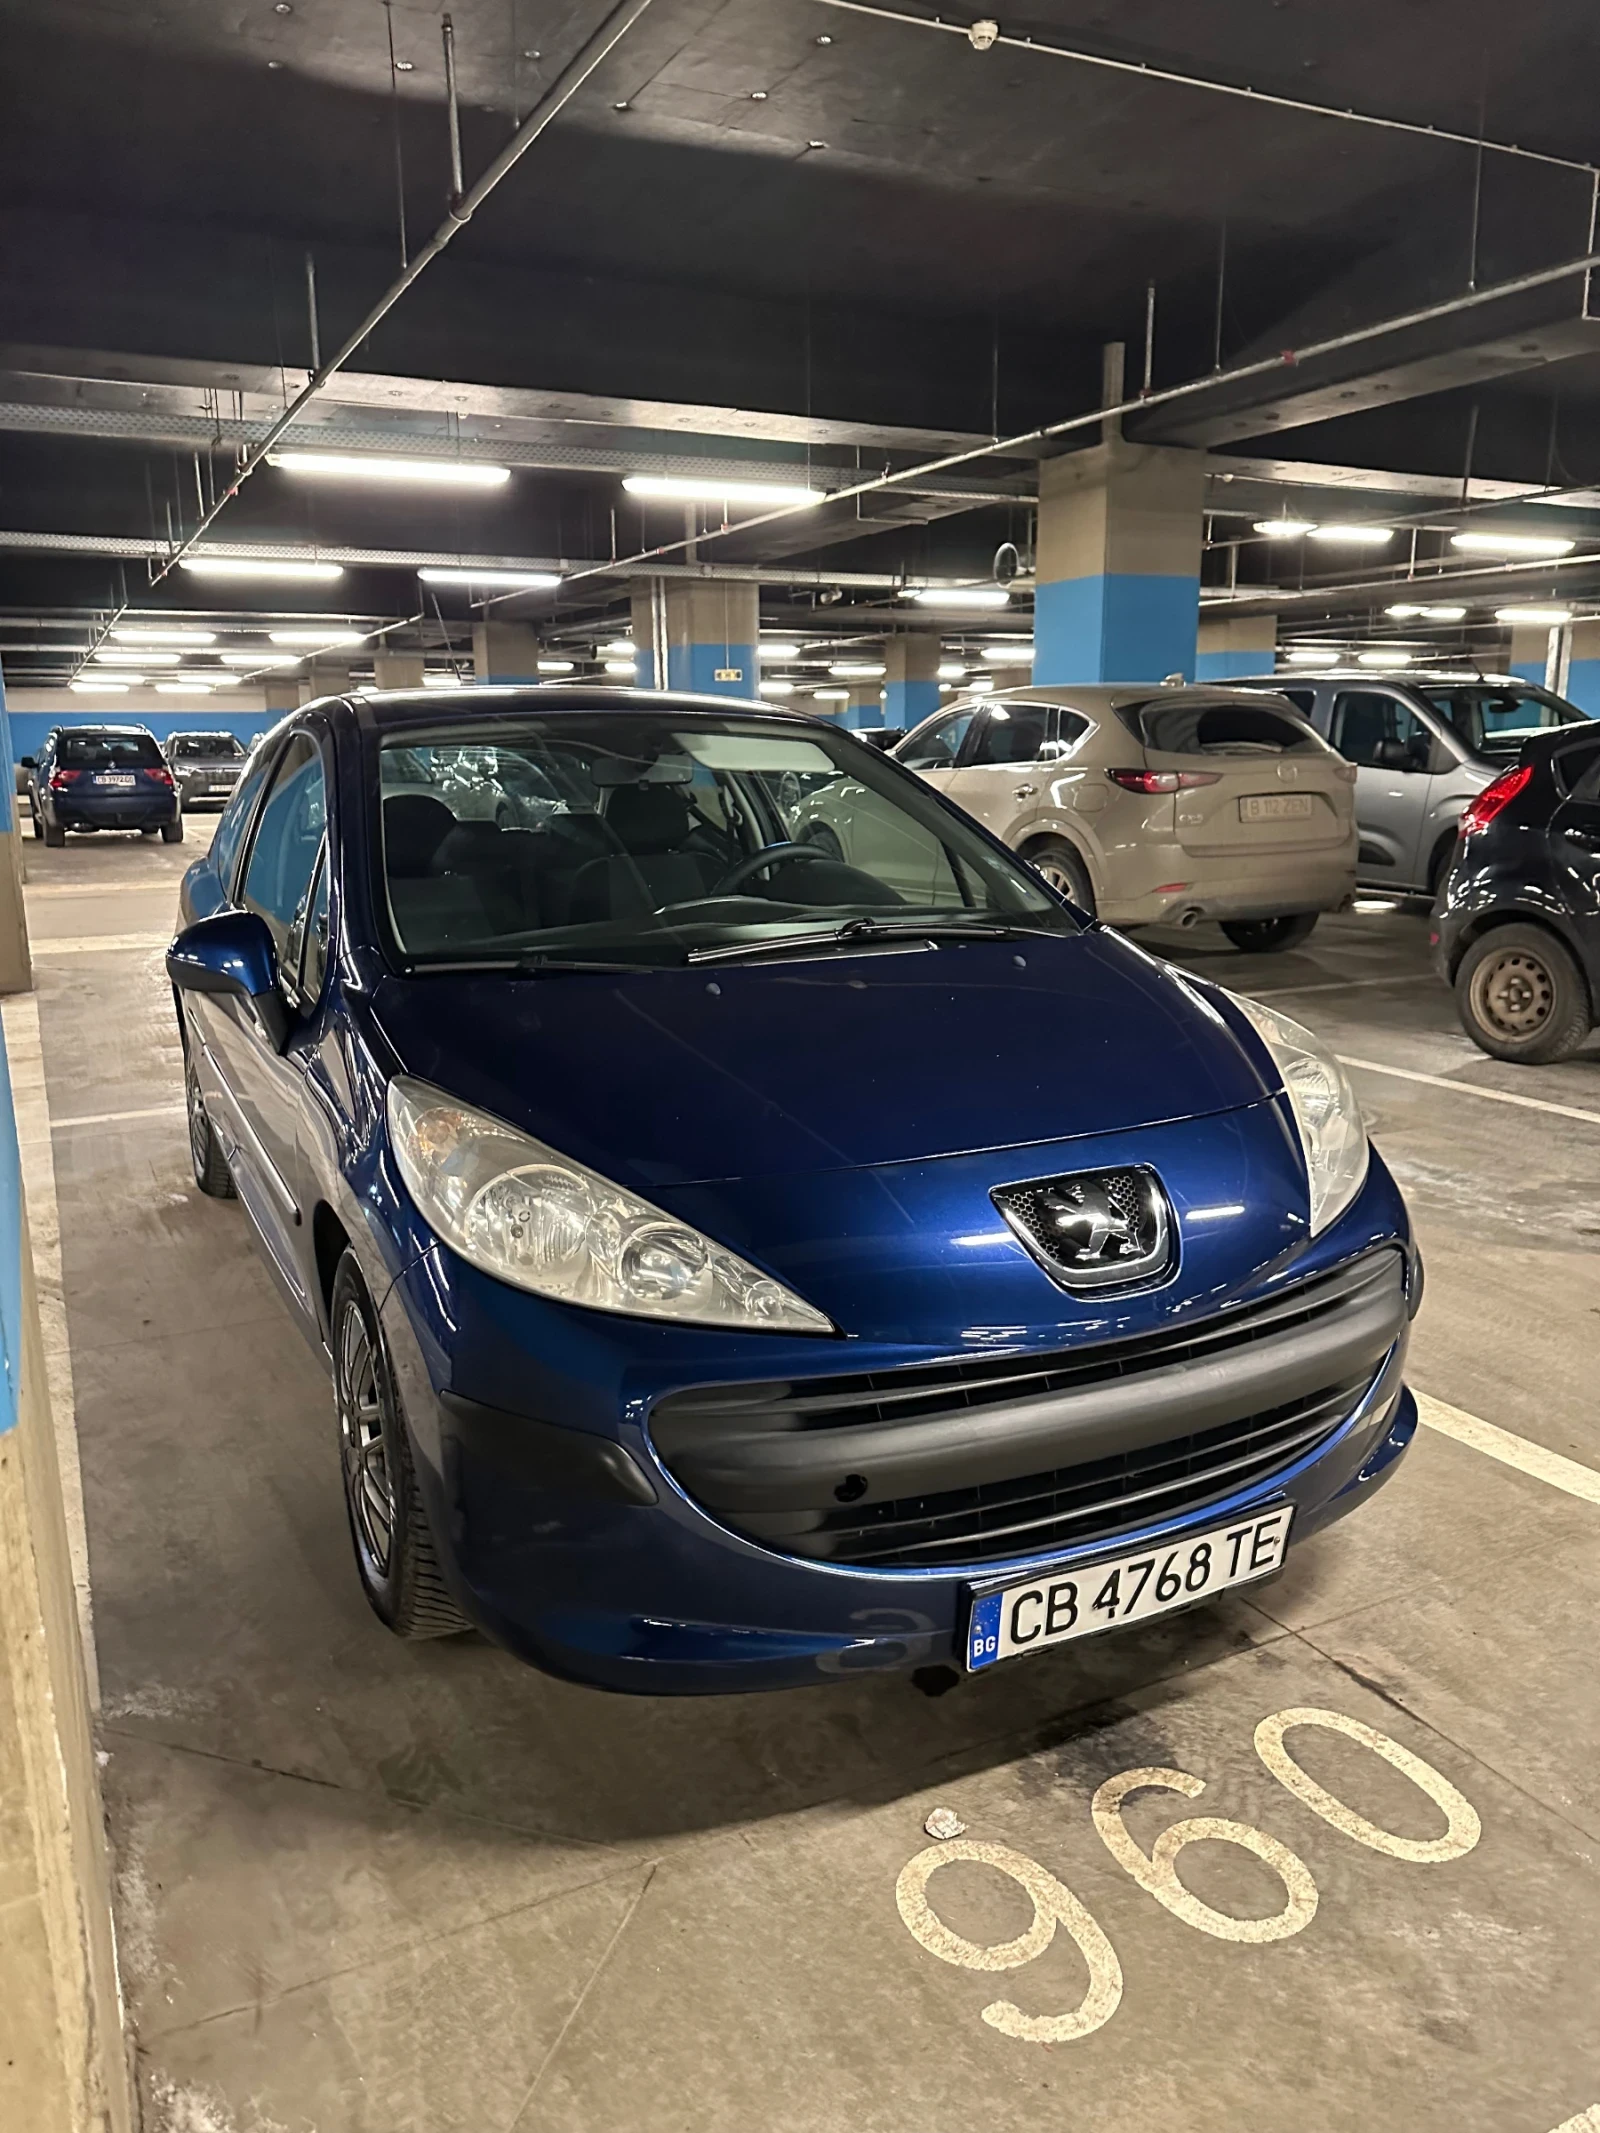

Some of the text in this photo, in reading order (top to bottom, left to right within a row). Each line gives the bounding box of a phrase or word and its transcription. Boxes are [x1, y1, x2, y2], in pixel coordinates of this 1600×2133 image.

[1250, 801, 1260, 816] B
[1011, 1517, 1282, 1645] CB 4768 TE
[973, 1637, 997, 1659] BG
[896, 1708, 1482, 2043] 960
